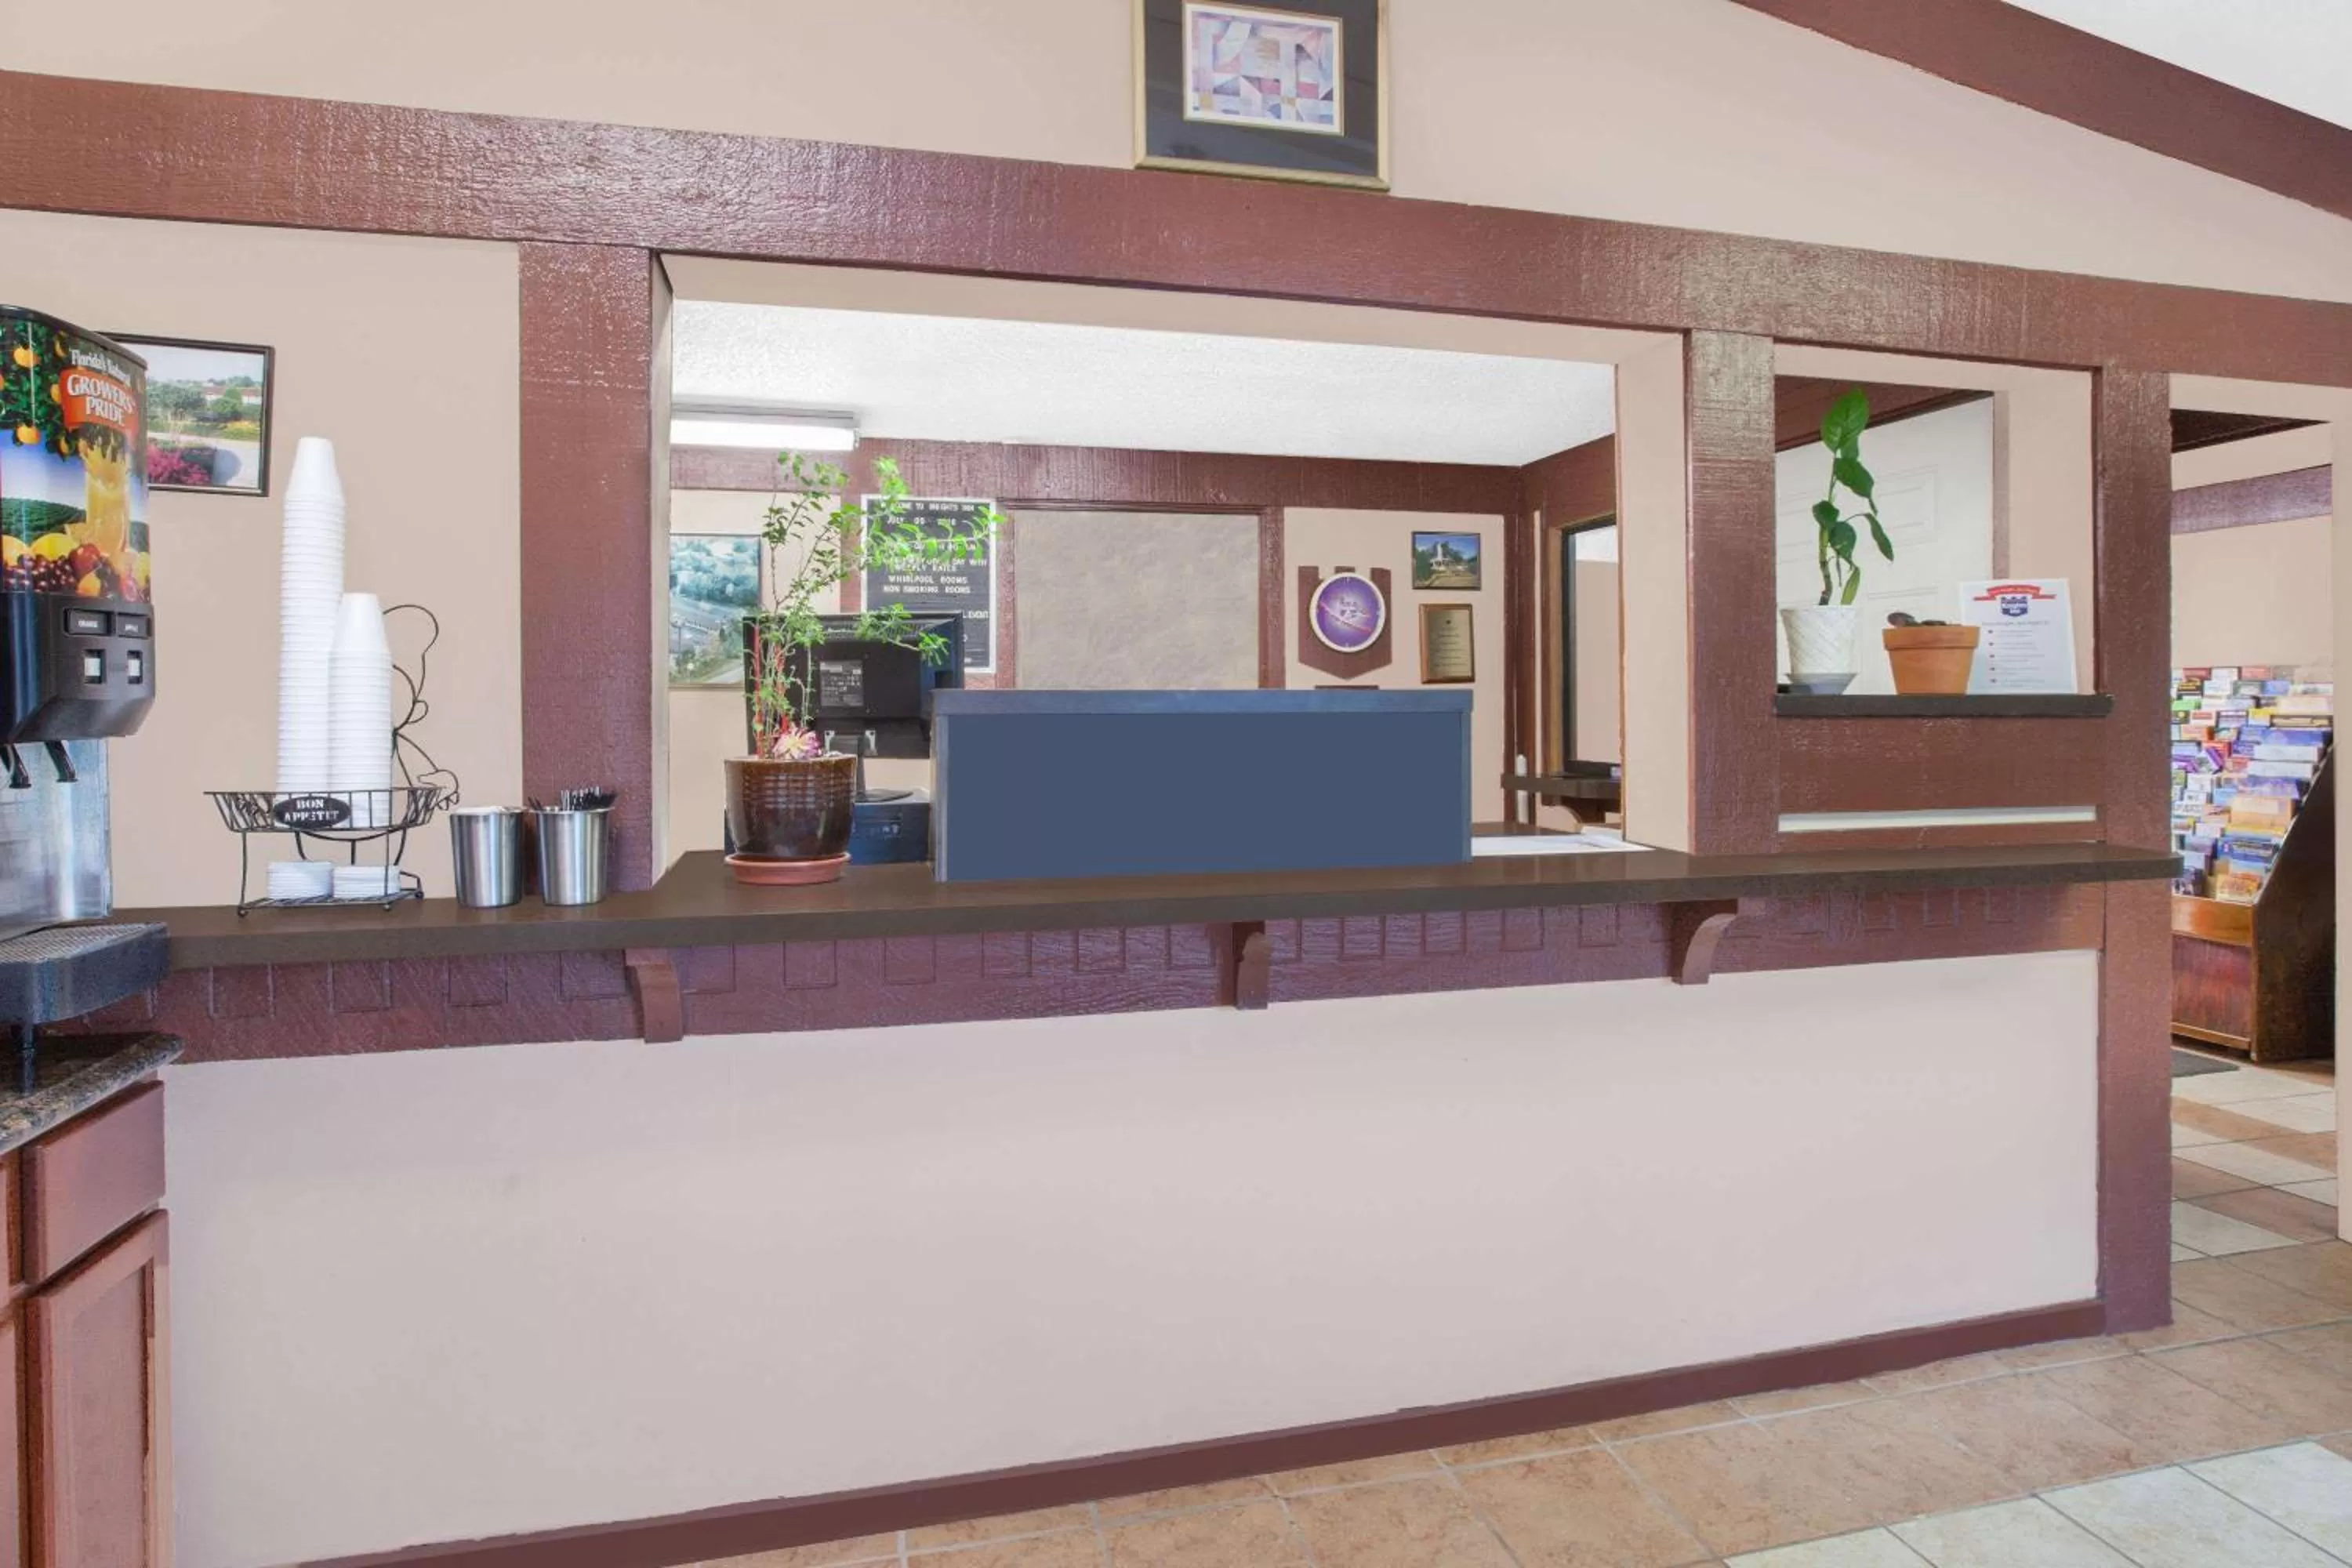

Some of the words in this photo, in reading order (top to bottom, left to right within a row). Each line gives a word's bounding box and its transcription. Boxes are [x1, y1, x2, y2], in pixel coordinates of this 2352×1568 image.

[86, 396, 125, 426] PRIDE
[887, 575, 934, 584] WHIRLPOOL
[884, 585, 901, 593] NON
[296, 799, 324, 809] BON
[285, 810, 339, 822] APPETIT
